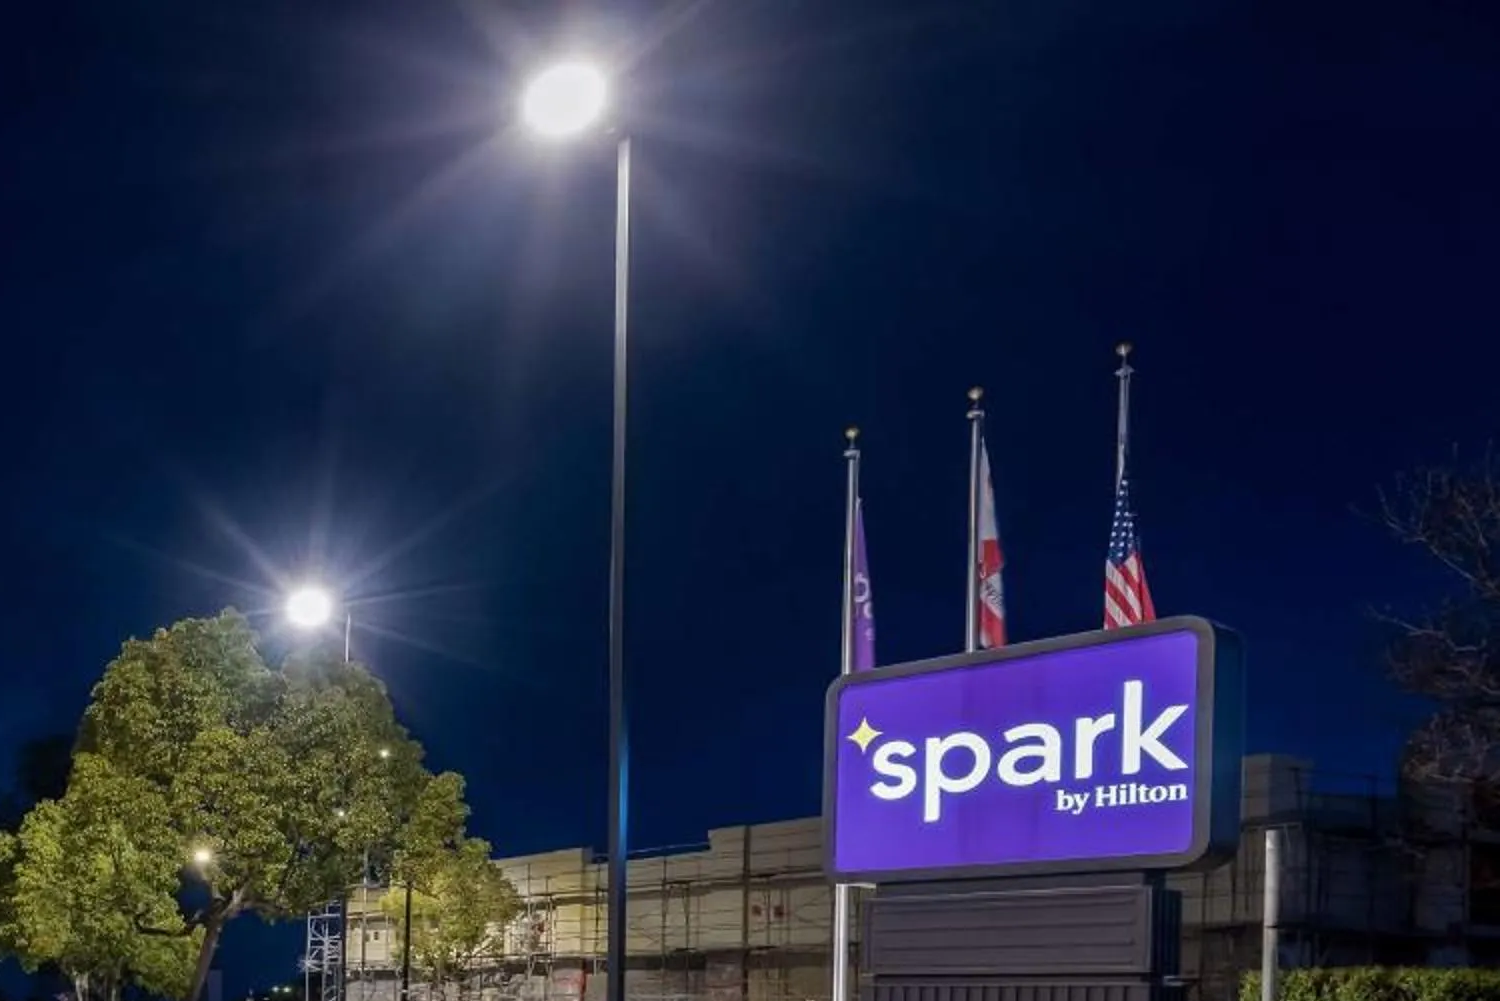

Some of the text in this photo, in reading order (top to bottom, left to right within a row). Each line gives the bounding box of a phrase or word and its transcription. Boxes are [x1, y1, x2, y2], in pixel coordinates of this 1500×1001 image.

[870, 679, 1189, 823] spark
[1056, 782, 1188, 815] by Hilton
